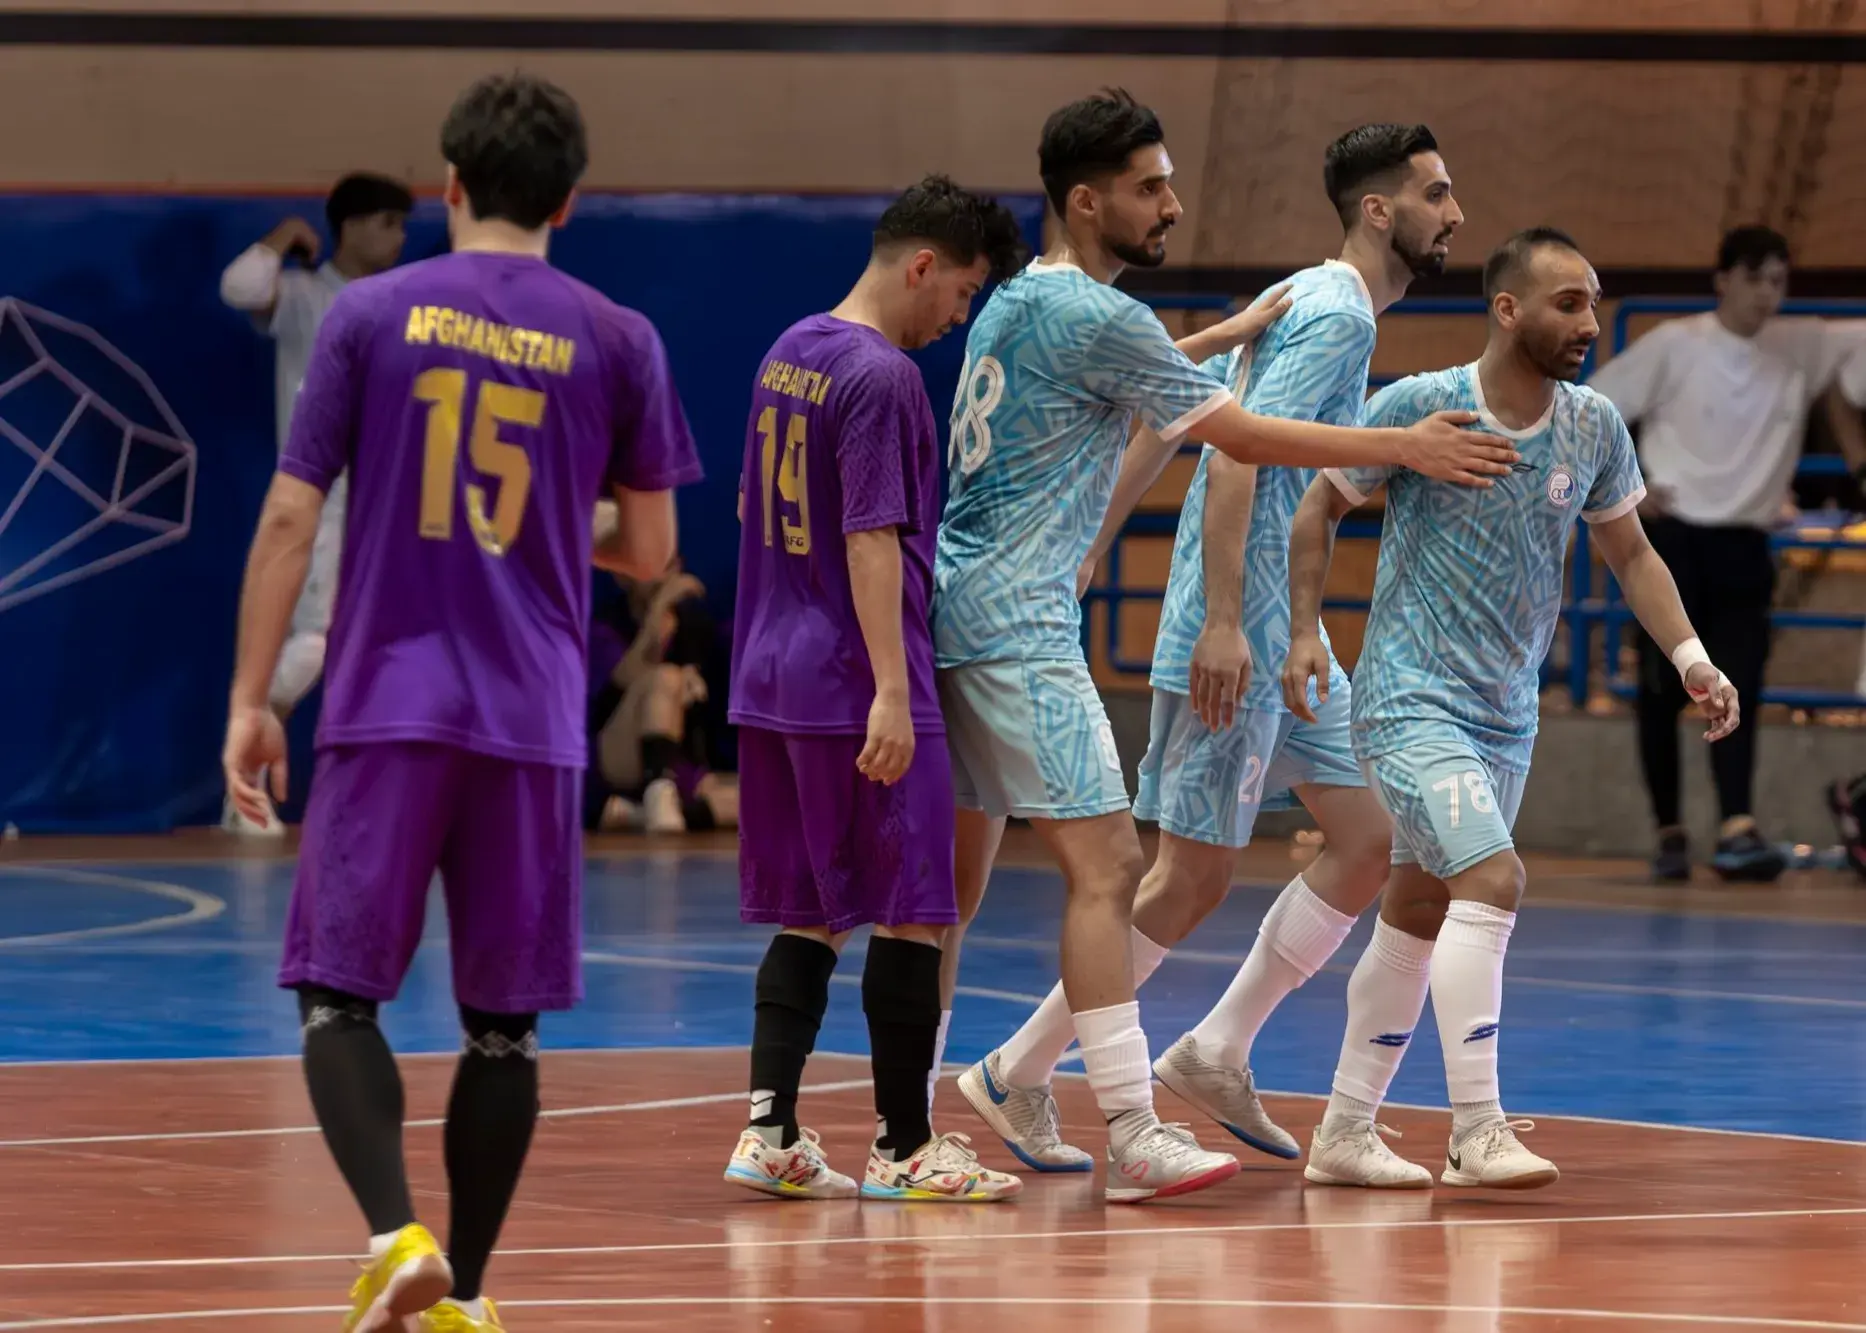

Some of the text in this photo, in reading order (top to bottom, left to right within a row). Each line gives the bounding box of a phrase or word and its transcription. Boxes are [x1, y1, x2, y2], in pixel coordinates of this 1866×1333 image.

[405, 306, 575, 375] AFGHANISTAN
[413, 366, 547, 557] 15
[757, 406, 811, 555] 19
[948, 352, 1005, 475] 8
